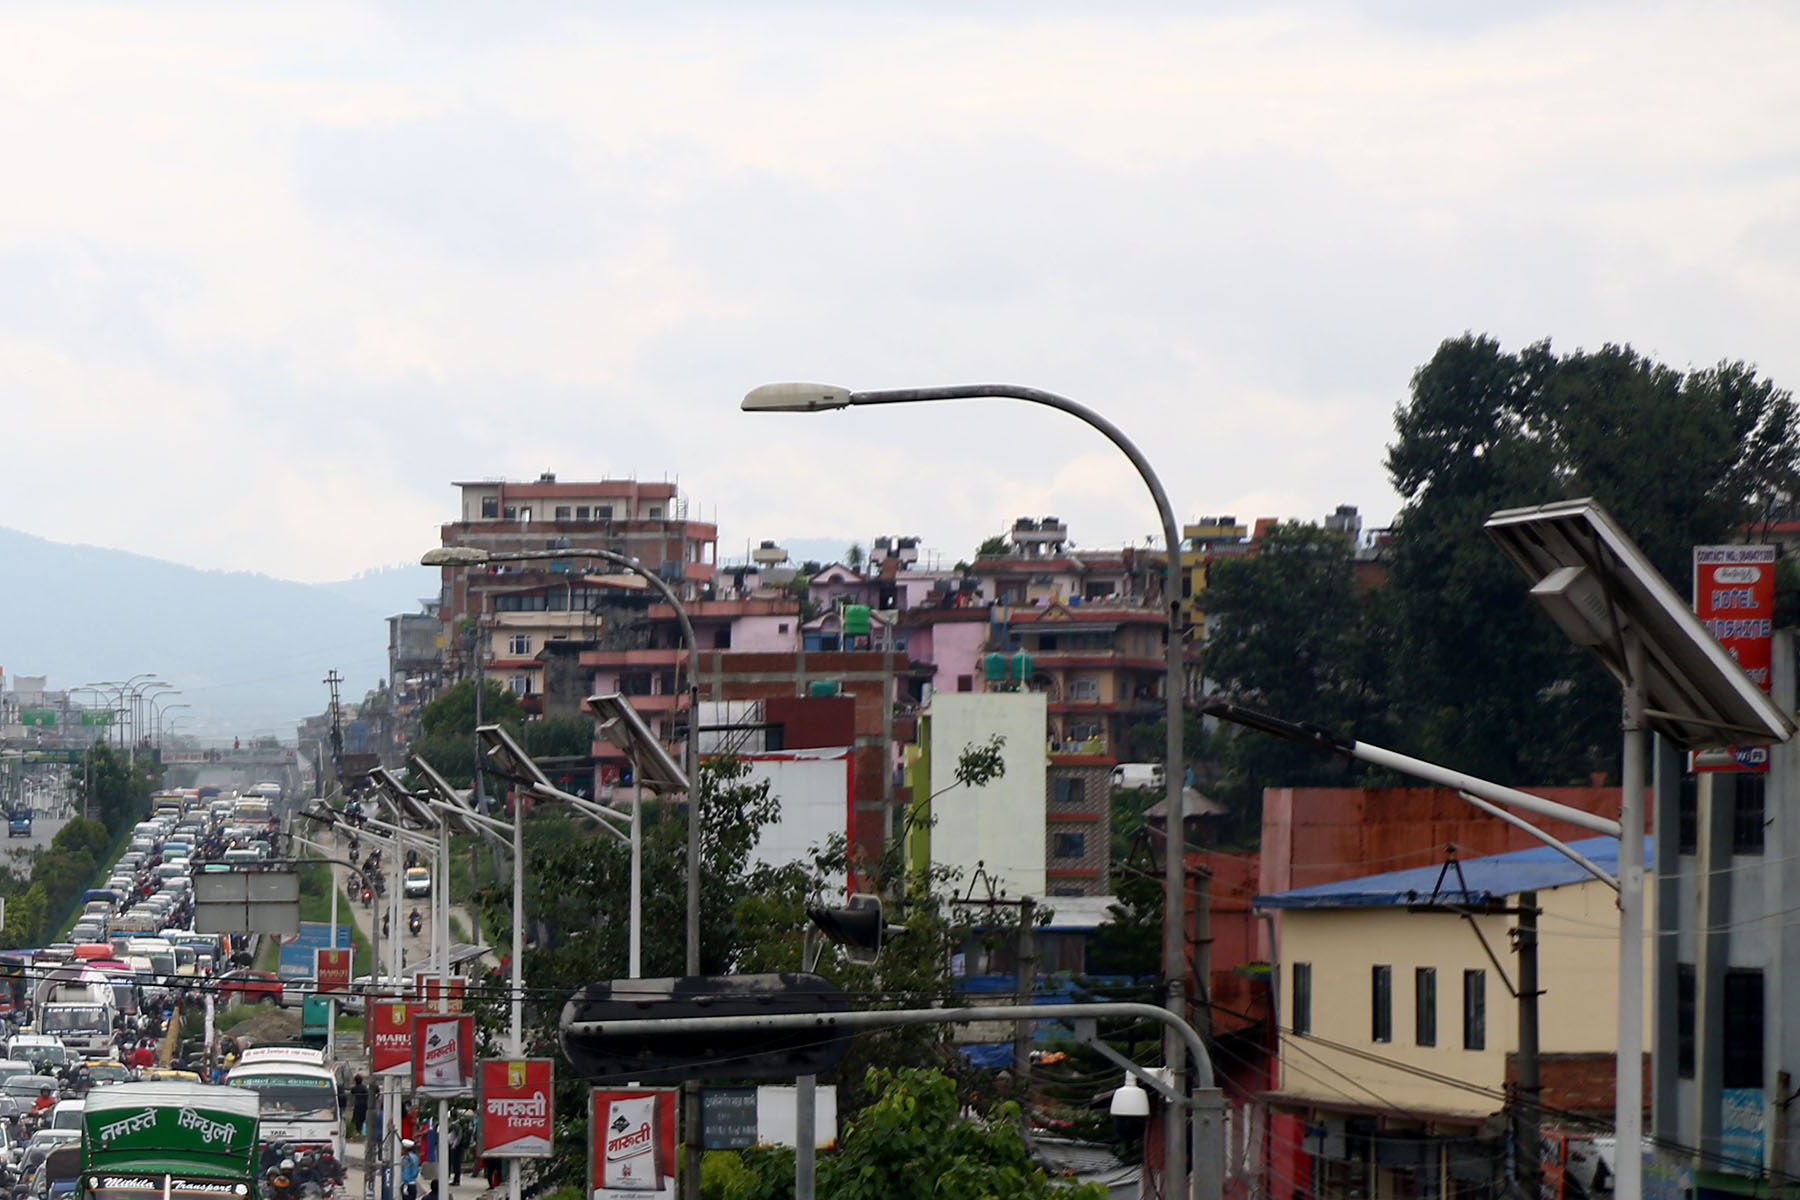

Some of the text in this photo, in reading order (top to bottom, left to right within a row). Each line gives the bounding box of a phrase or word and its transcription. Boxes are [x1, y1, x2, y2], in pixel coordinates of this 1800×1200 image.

[1711, 587, 1759, 611] HOTEL
[376, 1033, 412, 1042] MARU
[99, 1106, 238, 1145] नमस्ते सिन्धुली
[103, 1176, 233, 1193] Mithila Transport
